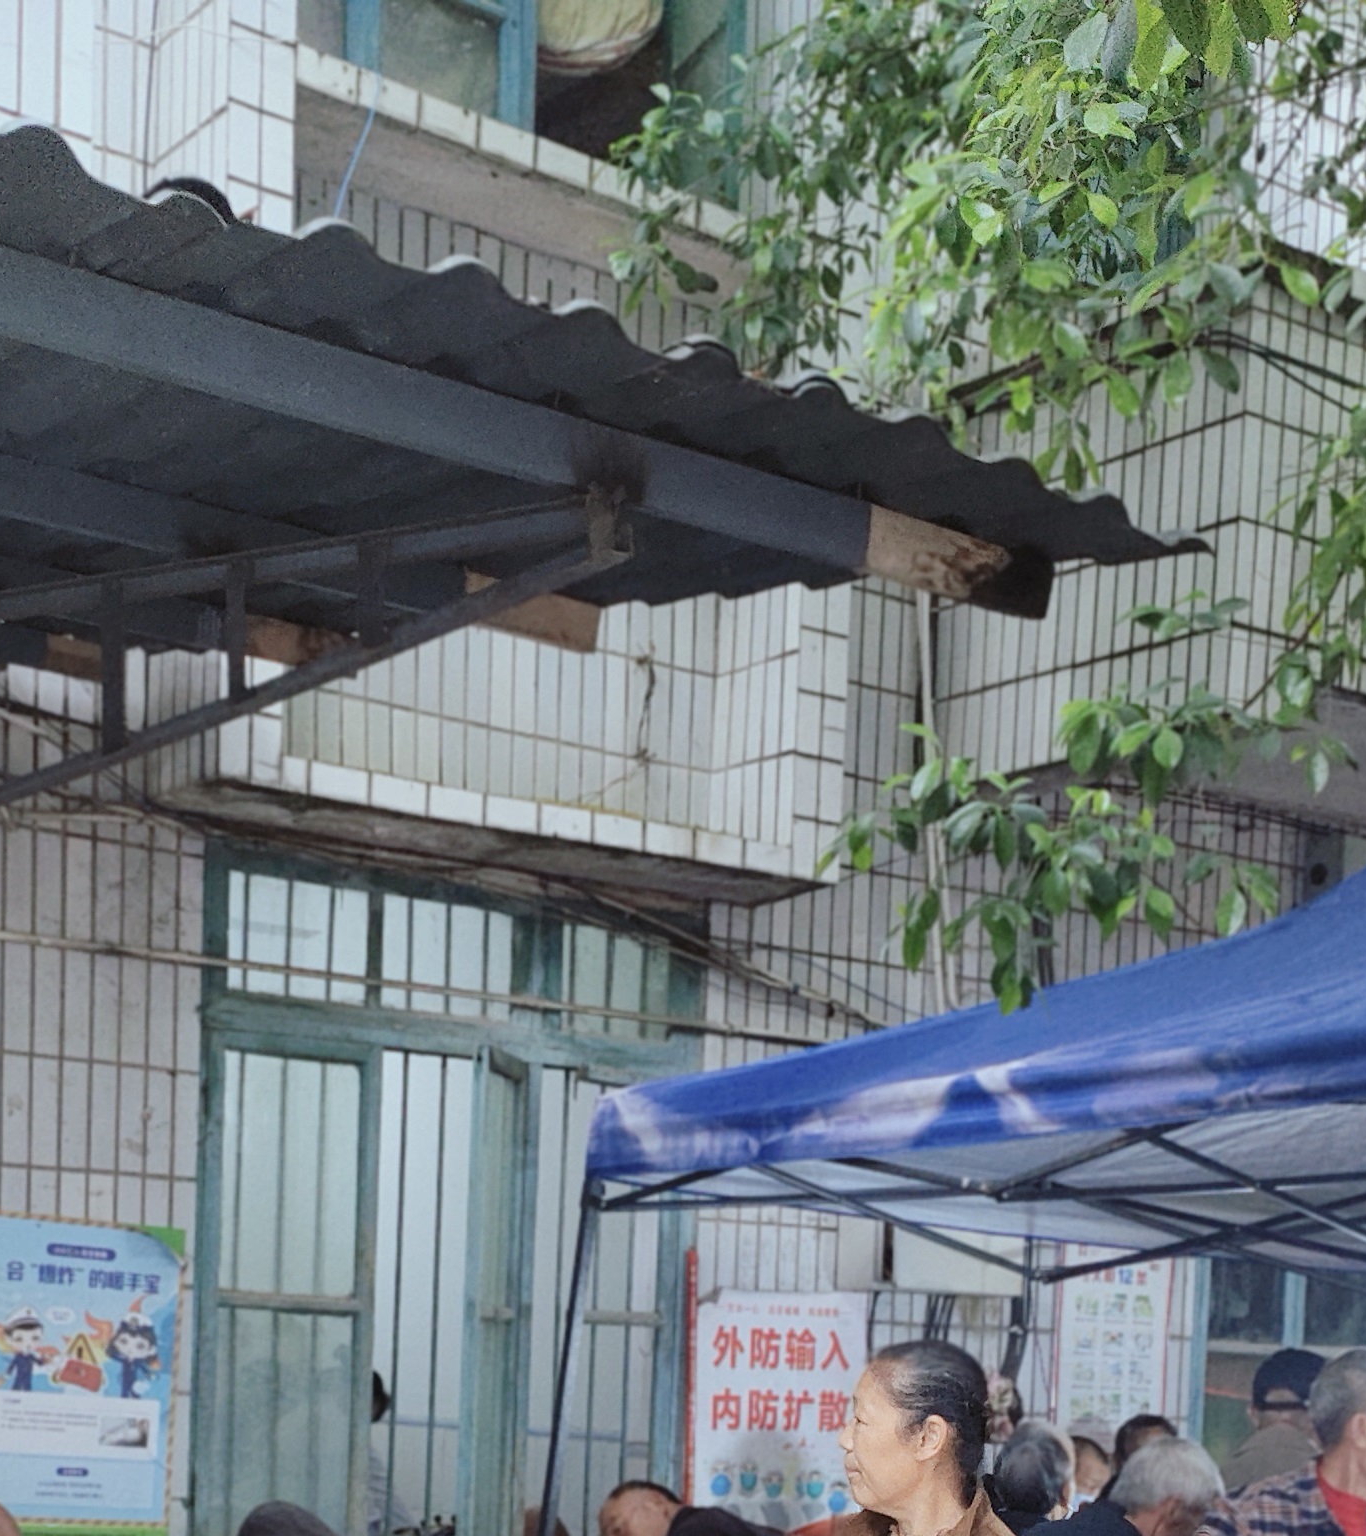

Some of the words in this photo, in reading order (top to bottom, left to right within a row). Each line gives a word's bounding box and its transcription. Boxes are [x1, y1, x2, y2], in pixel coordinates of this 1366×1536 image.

[711, 1325, 851, 1371] 外防输入
[710, 1388, 851, 1432] 内防扩散
